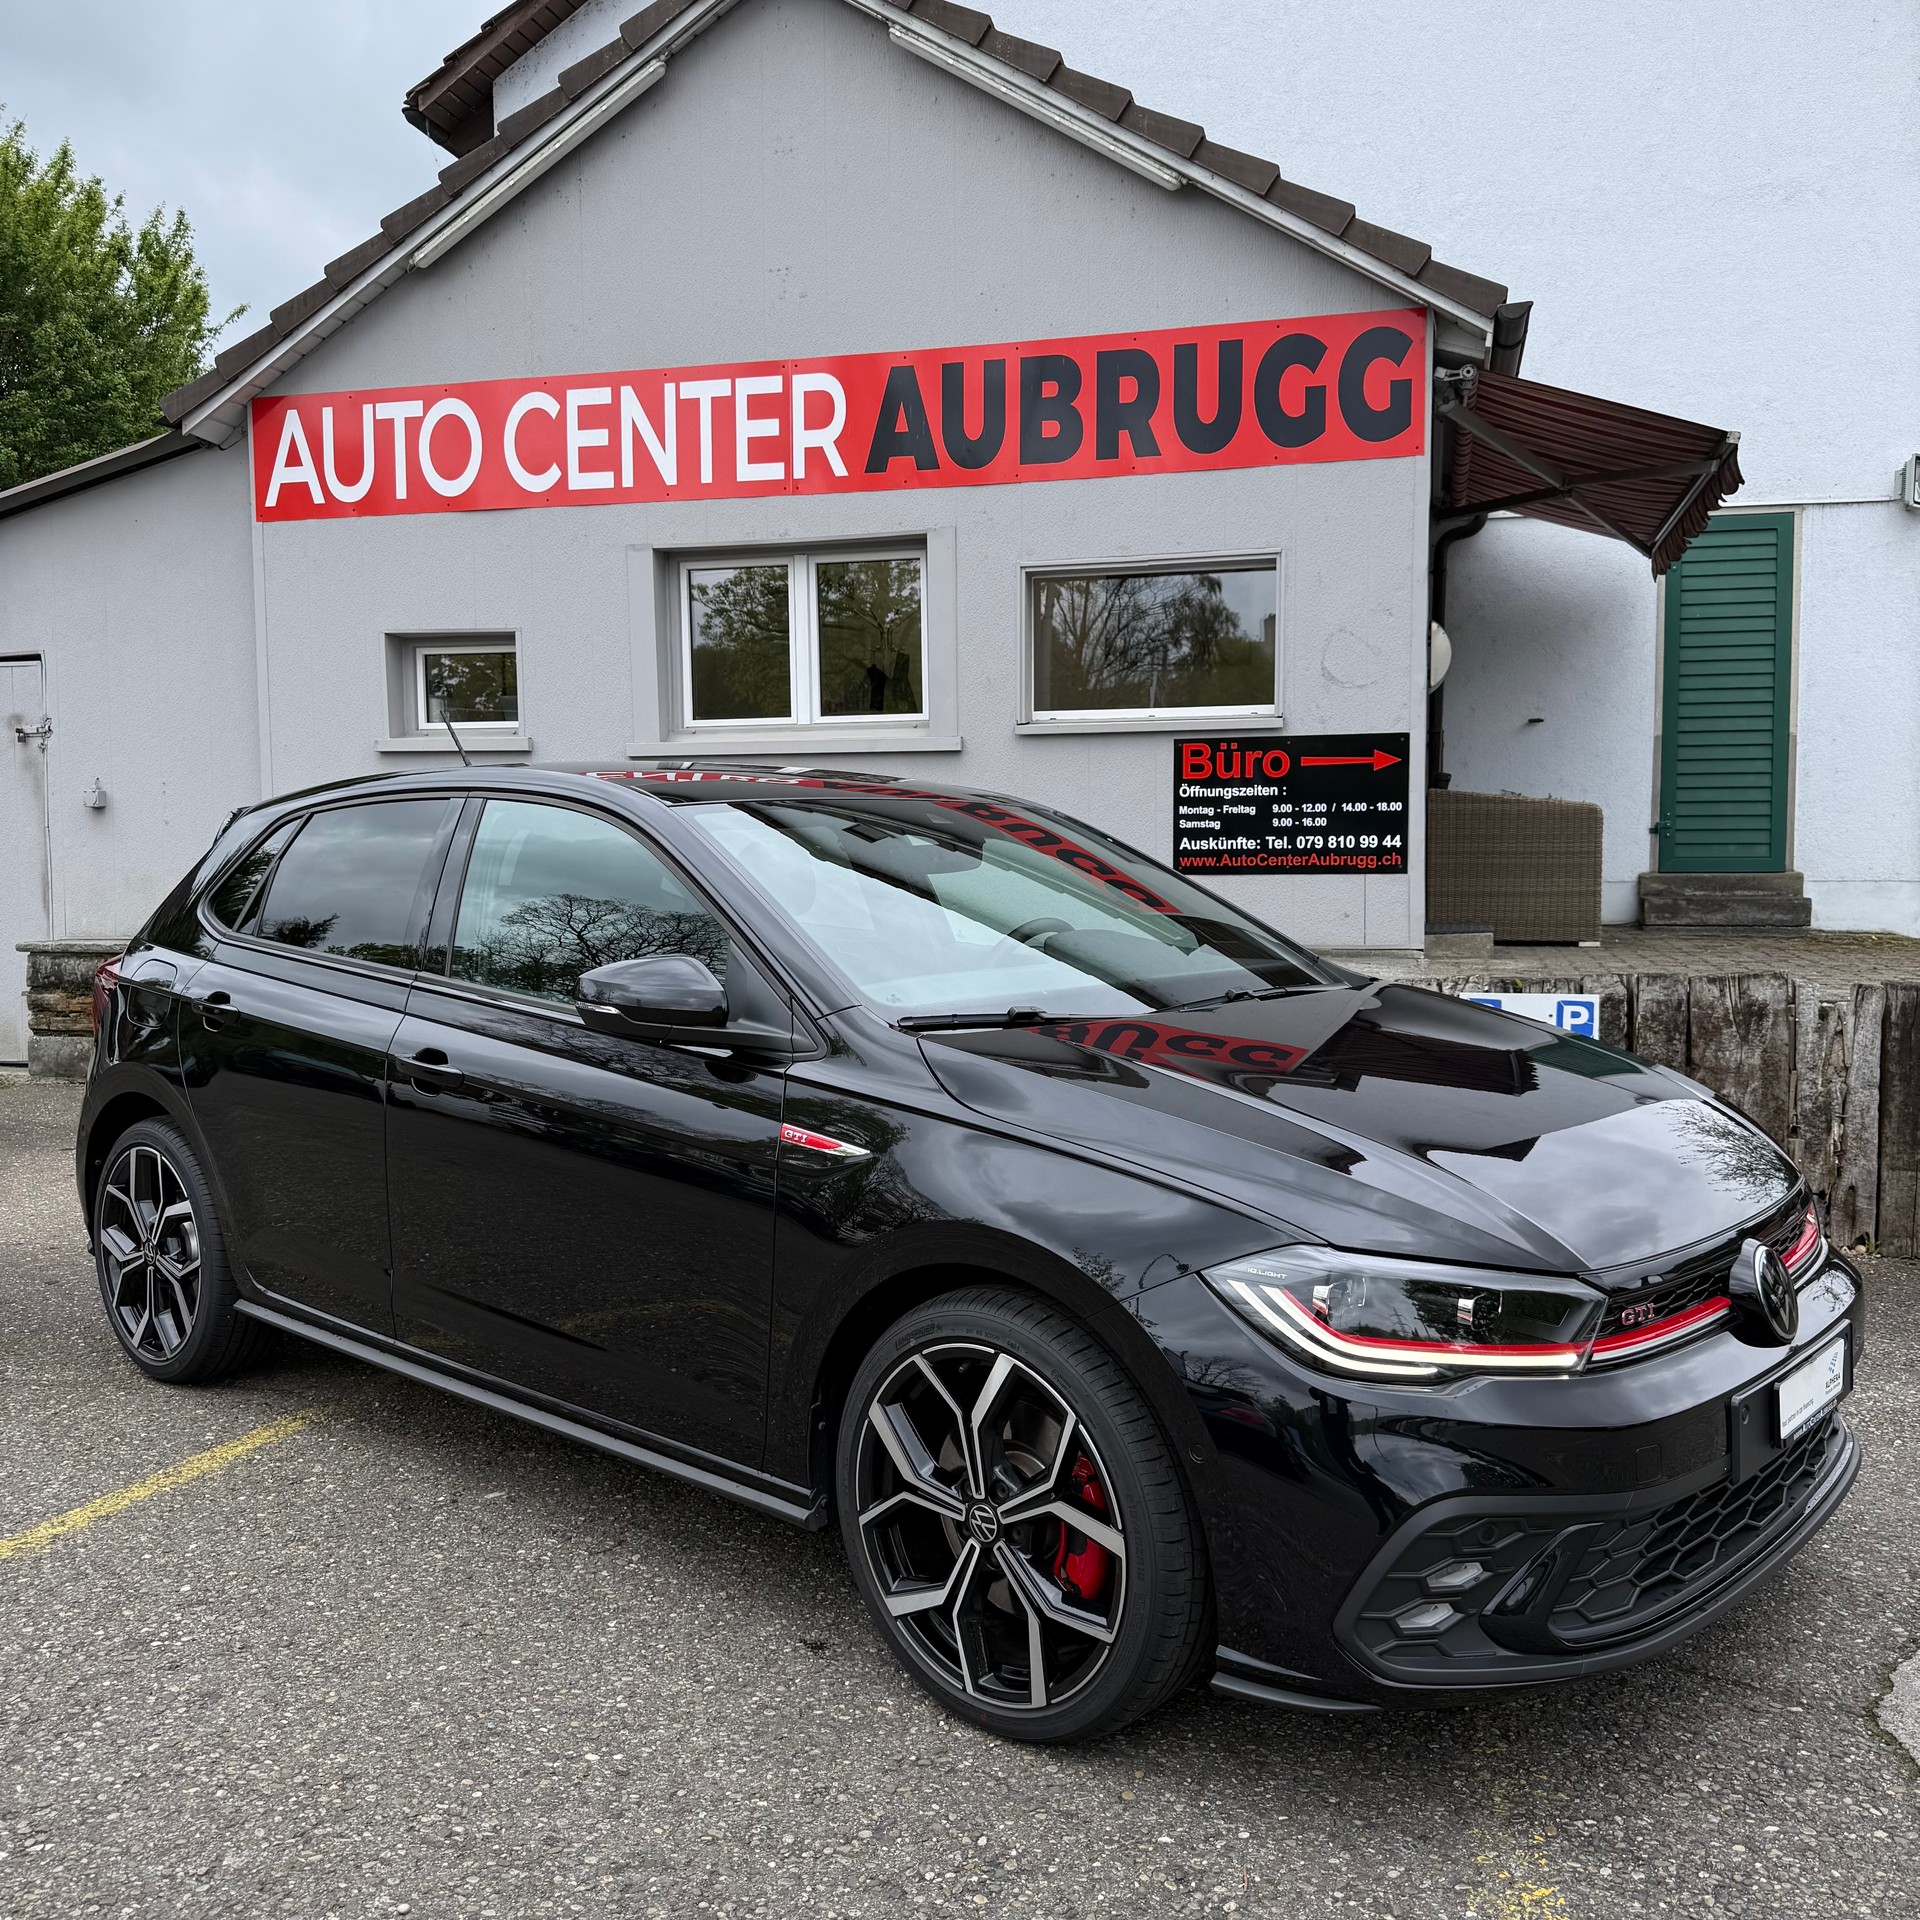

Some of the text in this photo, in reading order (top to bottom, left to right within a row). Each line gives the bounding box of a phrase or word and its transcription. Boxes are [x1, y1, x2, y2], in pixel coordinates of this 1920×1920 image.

[264, 326, 1414, 507] AUTO CENTER AUBRUGG
[1182, 743, 1291, 780] Büro
[1179, 783, 1279, 800] Öffnungszeiten
[1178, 805, 1215, 817] Montag
[1222, 804, 1257, 816] Freitag
[1272, 803, 1293, 813] 9.00
[1301, 803, 1328, 813] 12.00
[1341, 802, 1368, 812] 14.00
[1376, 801, 1403, 812] 18.00
[1178, 819, 1221, 831] Samstag
[1272, 817, 1293, 827] 9.00
[1301, 817, 1328, 827] 16.00
[1179, 834, 1403, 850] Auskünfte: Tel. 079 810 99 44
[1179, 852, 1403, 869] www.AutoCenterAubrugg.ch
[1563, 1005, 1589, 1032] P
[784, 1129, 808, 1143] GTI
[1621, 1302, 1656, 1326] GTI
